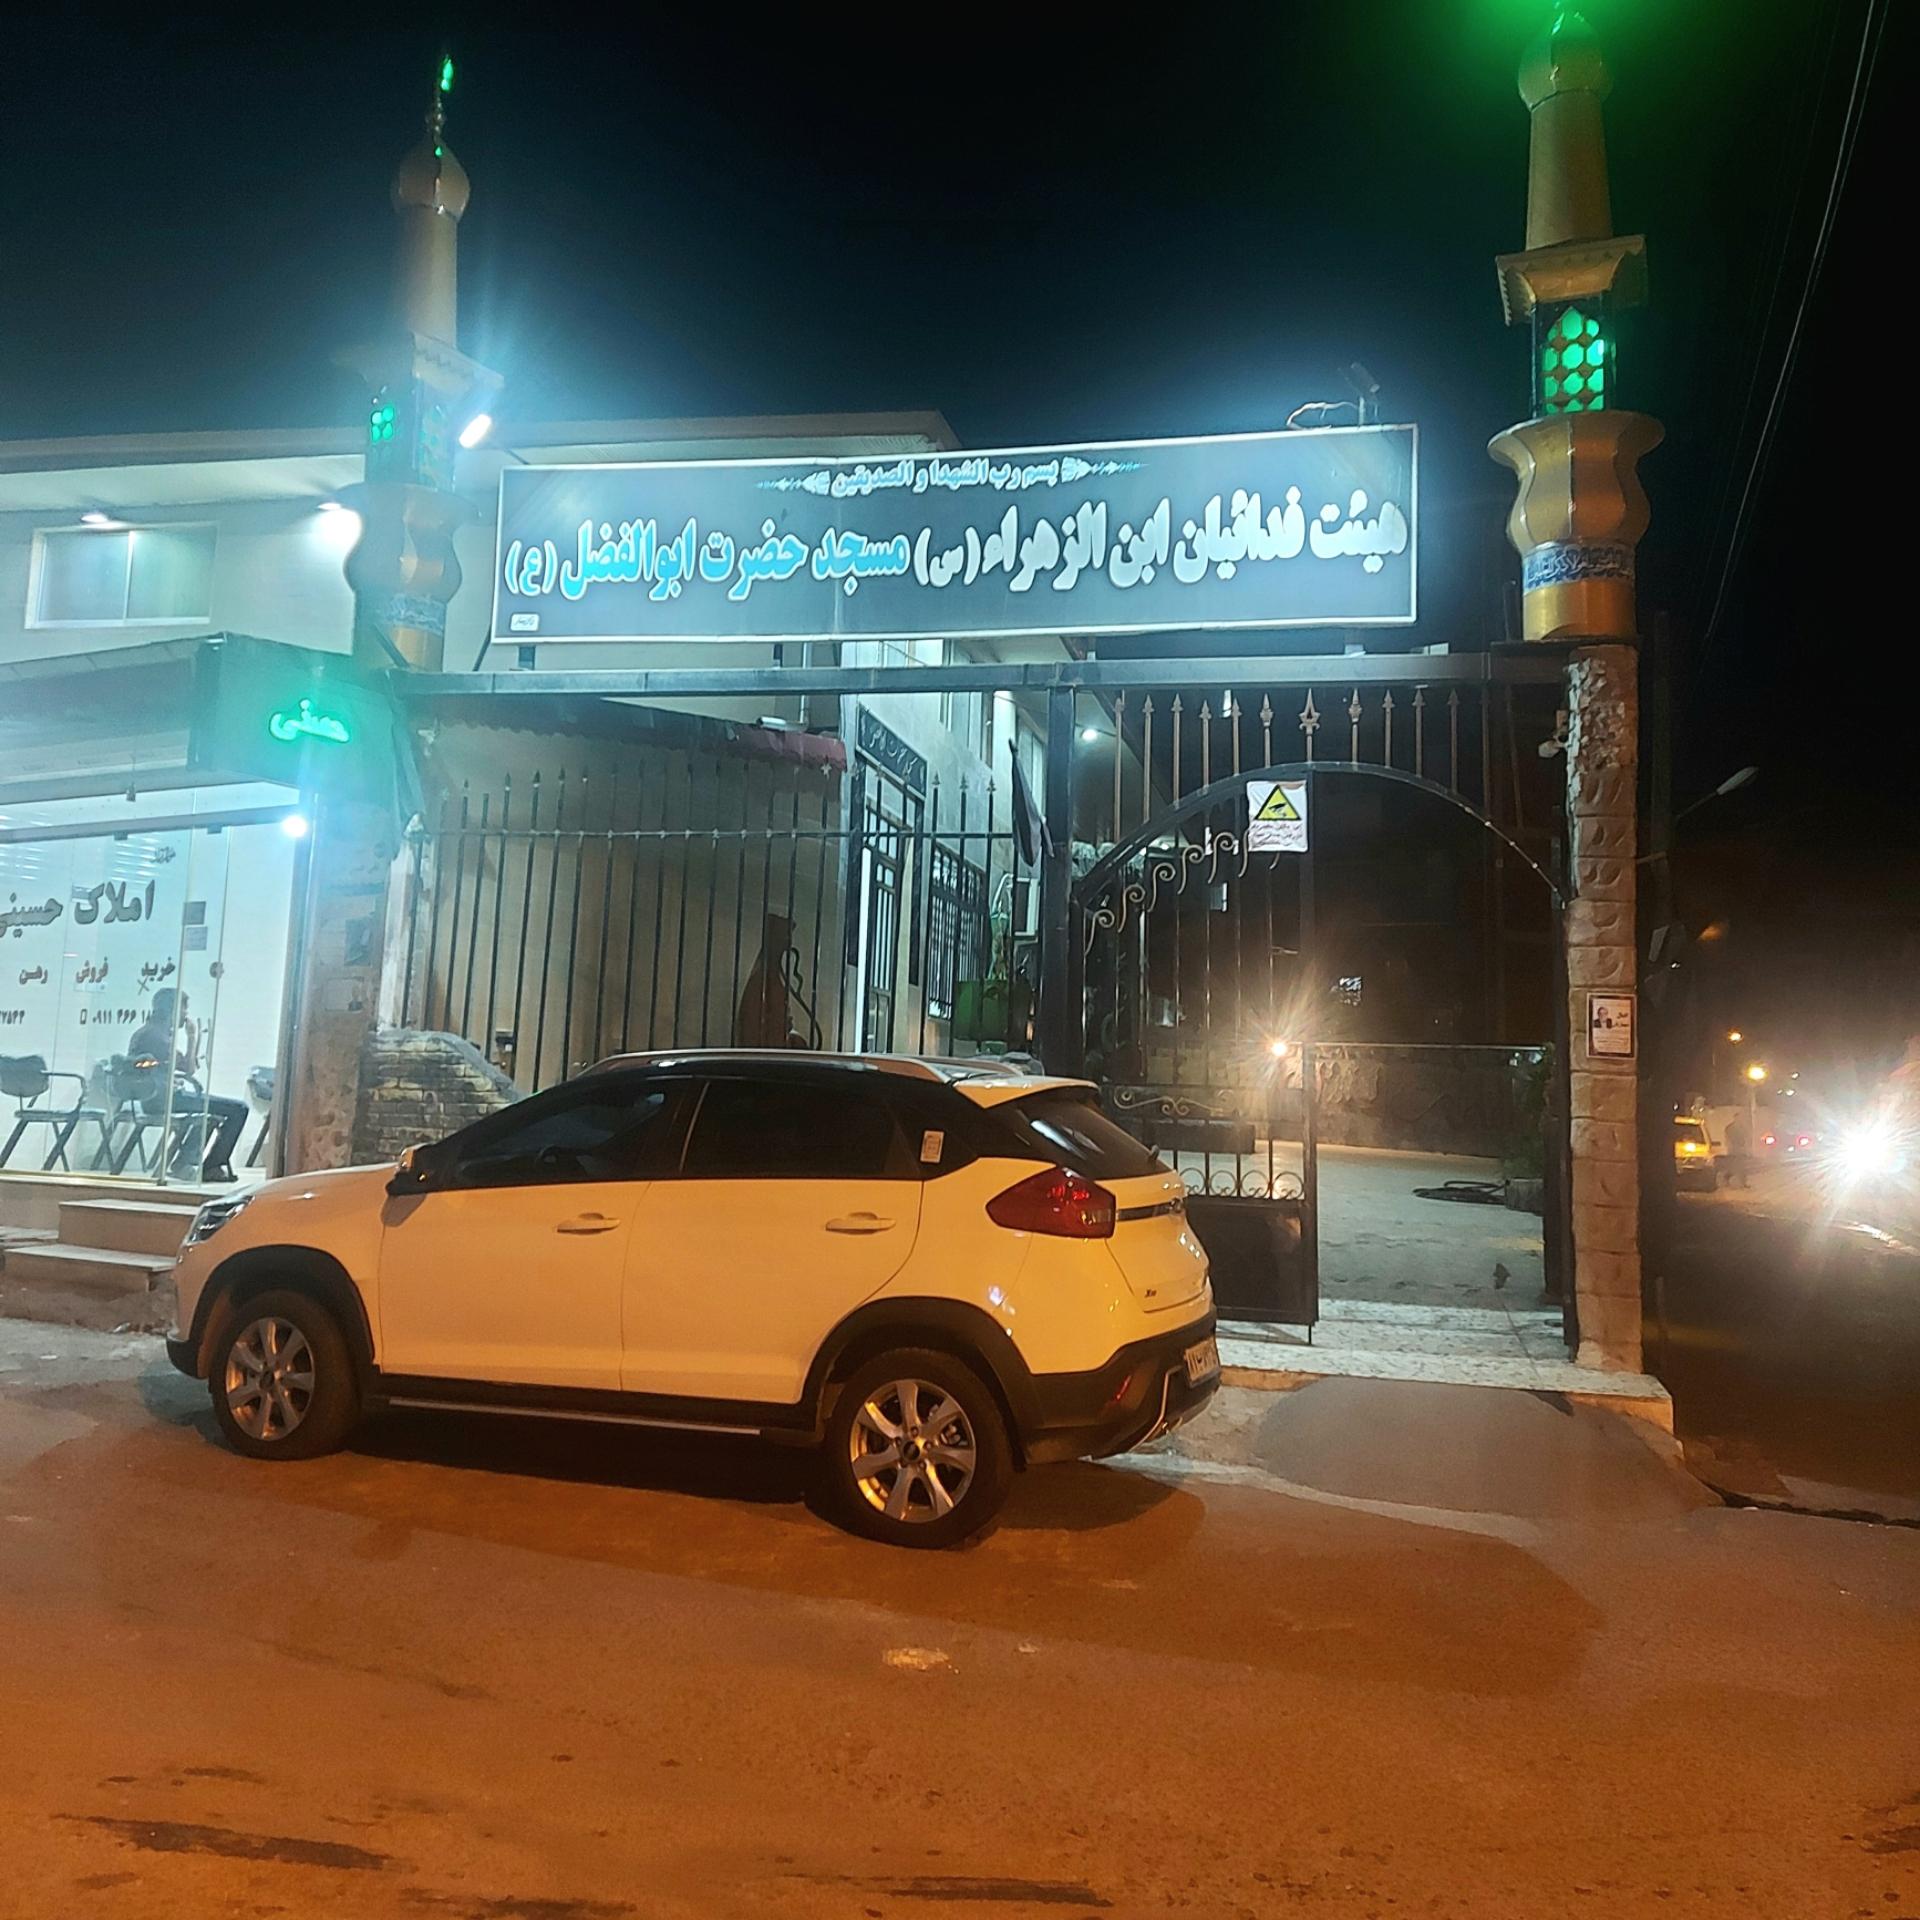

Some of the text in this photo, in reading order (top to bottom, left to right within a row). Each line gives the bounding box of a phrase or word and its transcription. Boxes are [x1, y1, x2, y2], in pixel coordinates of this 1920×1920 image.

[1022, 460, 1060, 489] بسم
[560, 517, 698, 601] ابوالفضل
[699, 517, 810, 601] حضرت
[812, 527, 911, 596] مسجد
[1109, 497, 1170, 588] ابن
[74, 880, 156, 925] املاک
[75, 956, 109, 984] فروش
[141, 956, 177, 982] خرید
